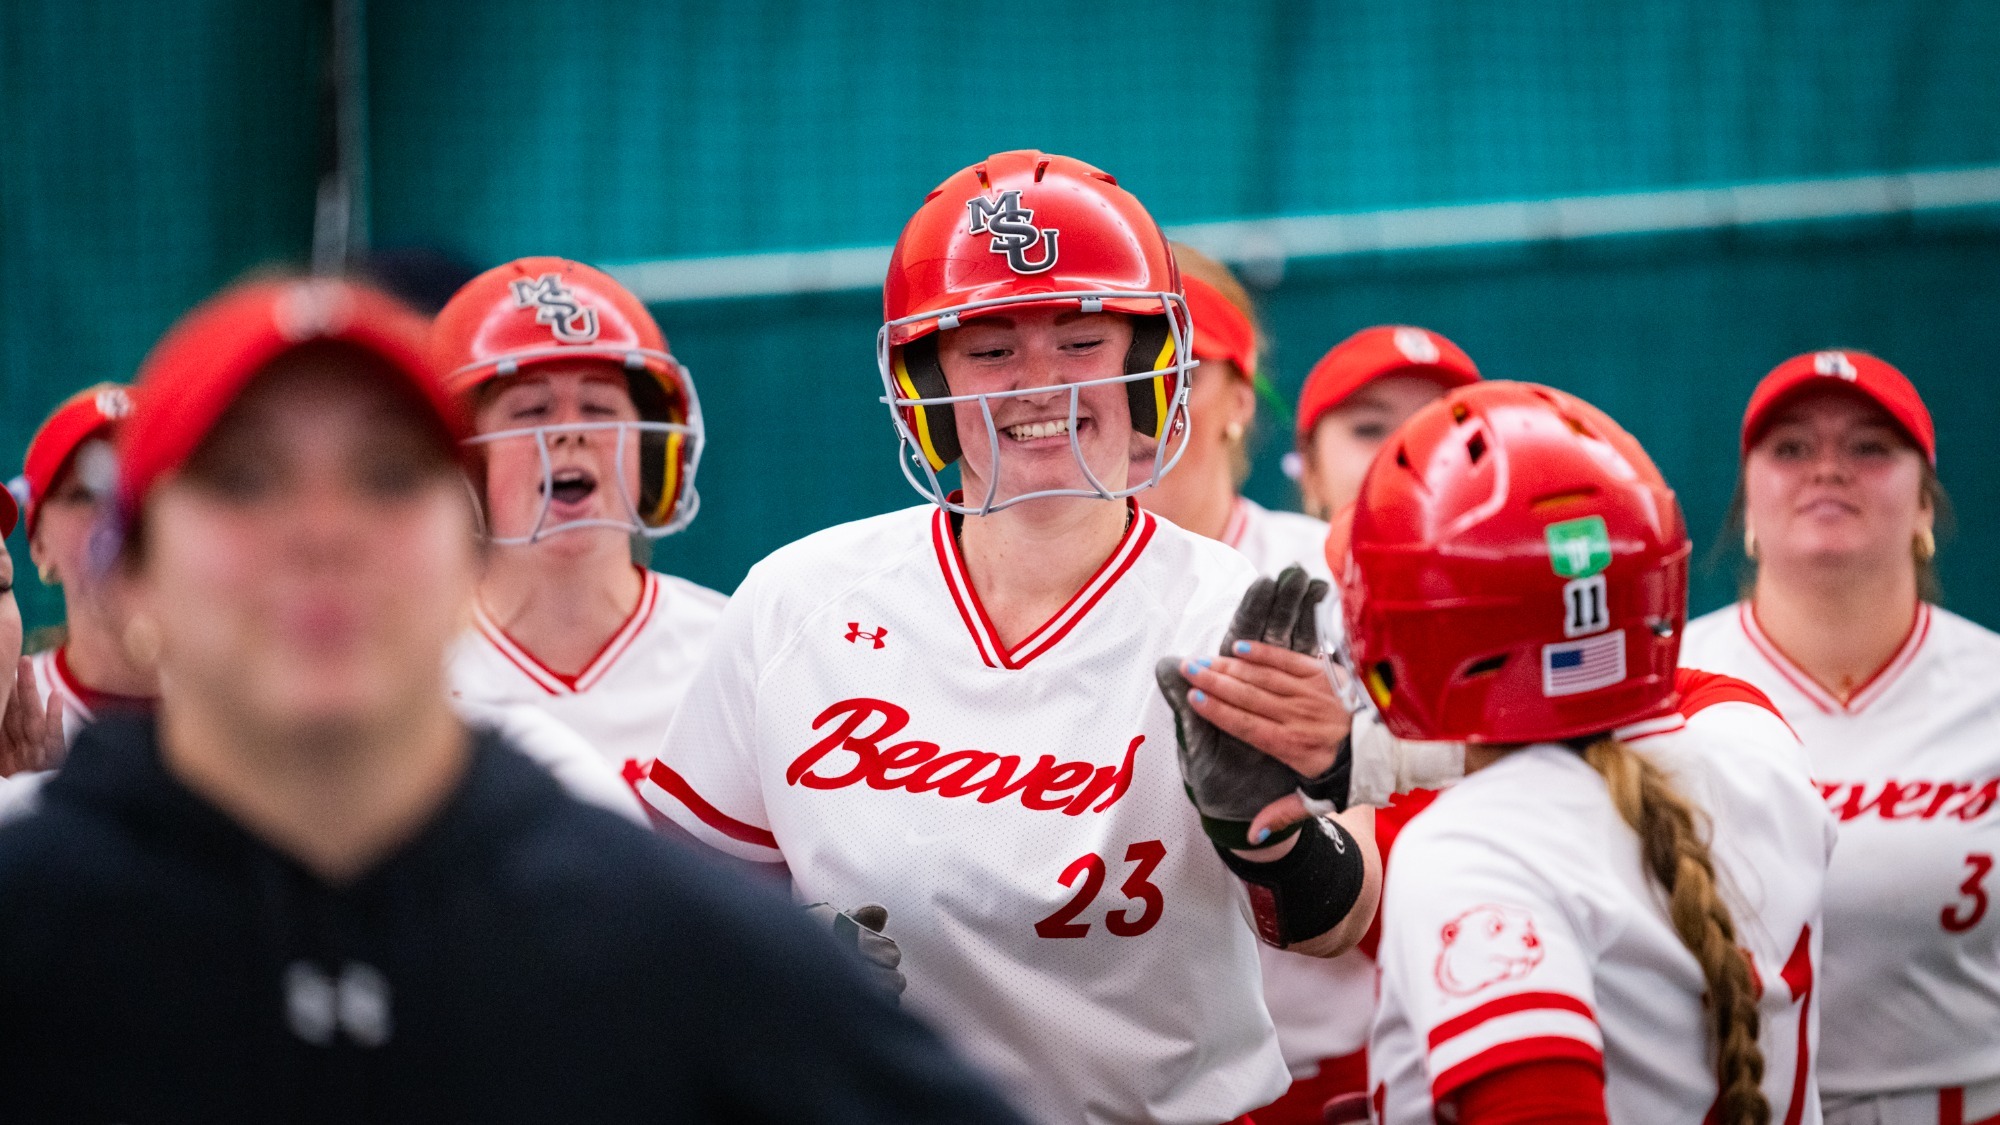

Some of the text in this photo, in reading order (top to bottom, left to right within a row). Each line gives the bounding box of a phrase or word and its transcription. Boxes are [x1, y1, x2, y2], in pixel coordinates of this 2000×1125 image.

[966, 190, 1059, 275] MSU
[508, 273, 600, 344] MSU
[1573, 585, 1601, 627] 11
[1034, 839, 1167, 939] 23
[1940, 853, 1993, 933] 3
